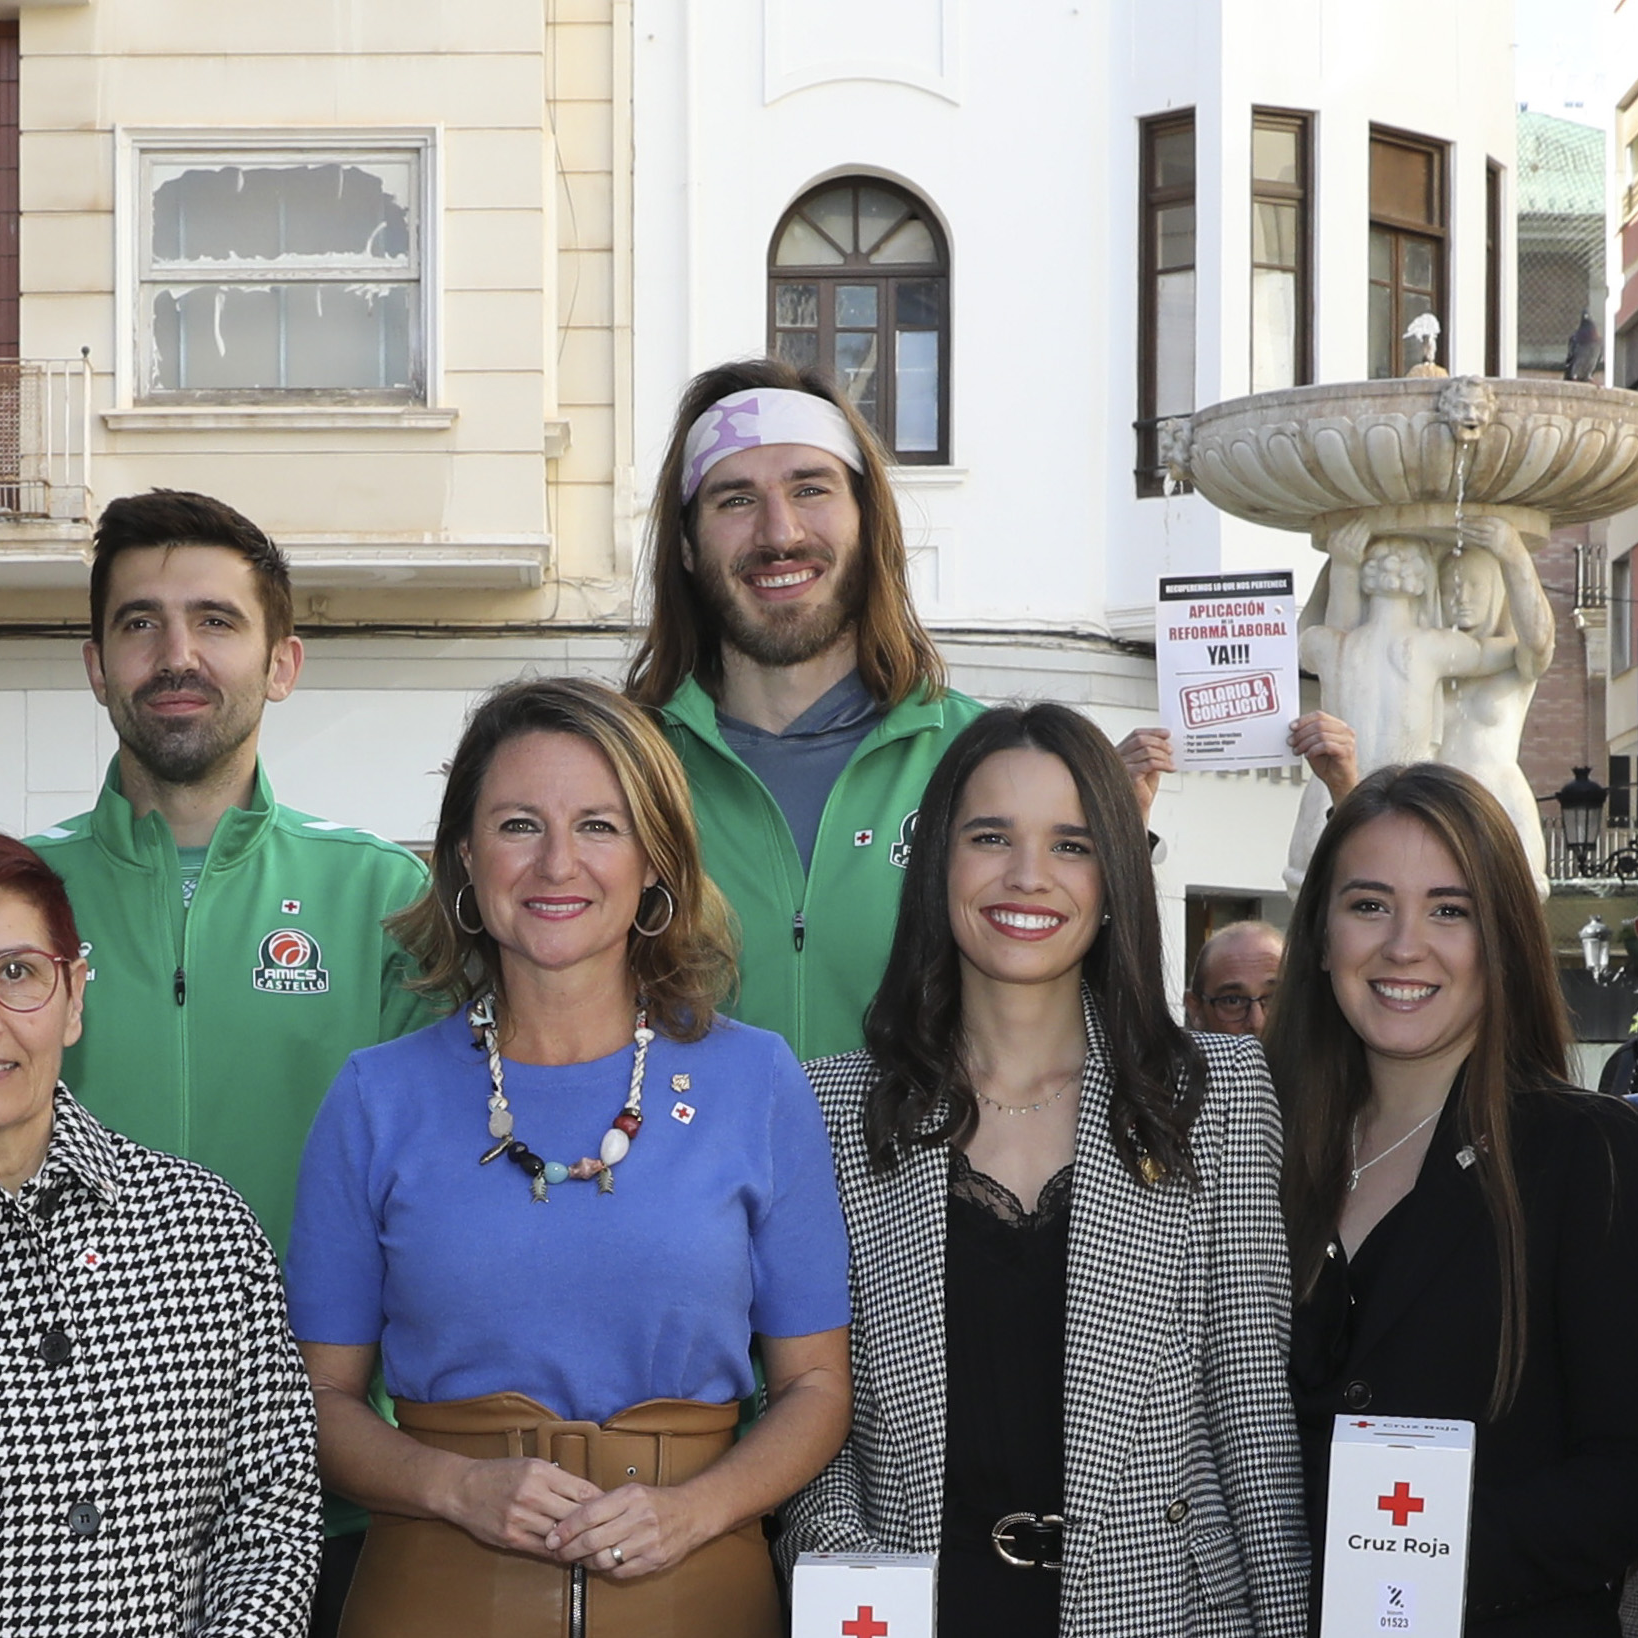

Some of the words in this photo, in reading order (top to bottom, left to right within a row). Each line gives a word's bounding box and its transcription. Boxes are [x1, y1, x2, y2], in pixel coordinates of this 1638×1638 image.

[1189, 600, 1265, 619] APLICACIÓN
[1169, 625, 1228, 641] REFORMA
[1231, 622, 1287, 638] LABORAL
[1207, 644, 1250, 666] YA!!!
[1189, 681, 1250, 707] SALARIO
[264, 969, 317, 980] AMICS
[257, 978, 325, 991] CASTELLÓ
[1348, 1535, 1397, 1552] Cruz
[1403, 1538, 1450, 1557] Roja
[1380, 1617, 1409, 1628] 01523
